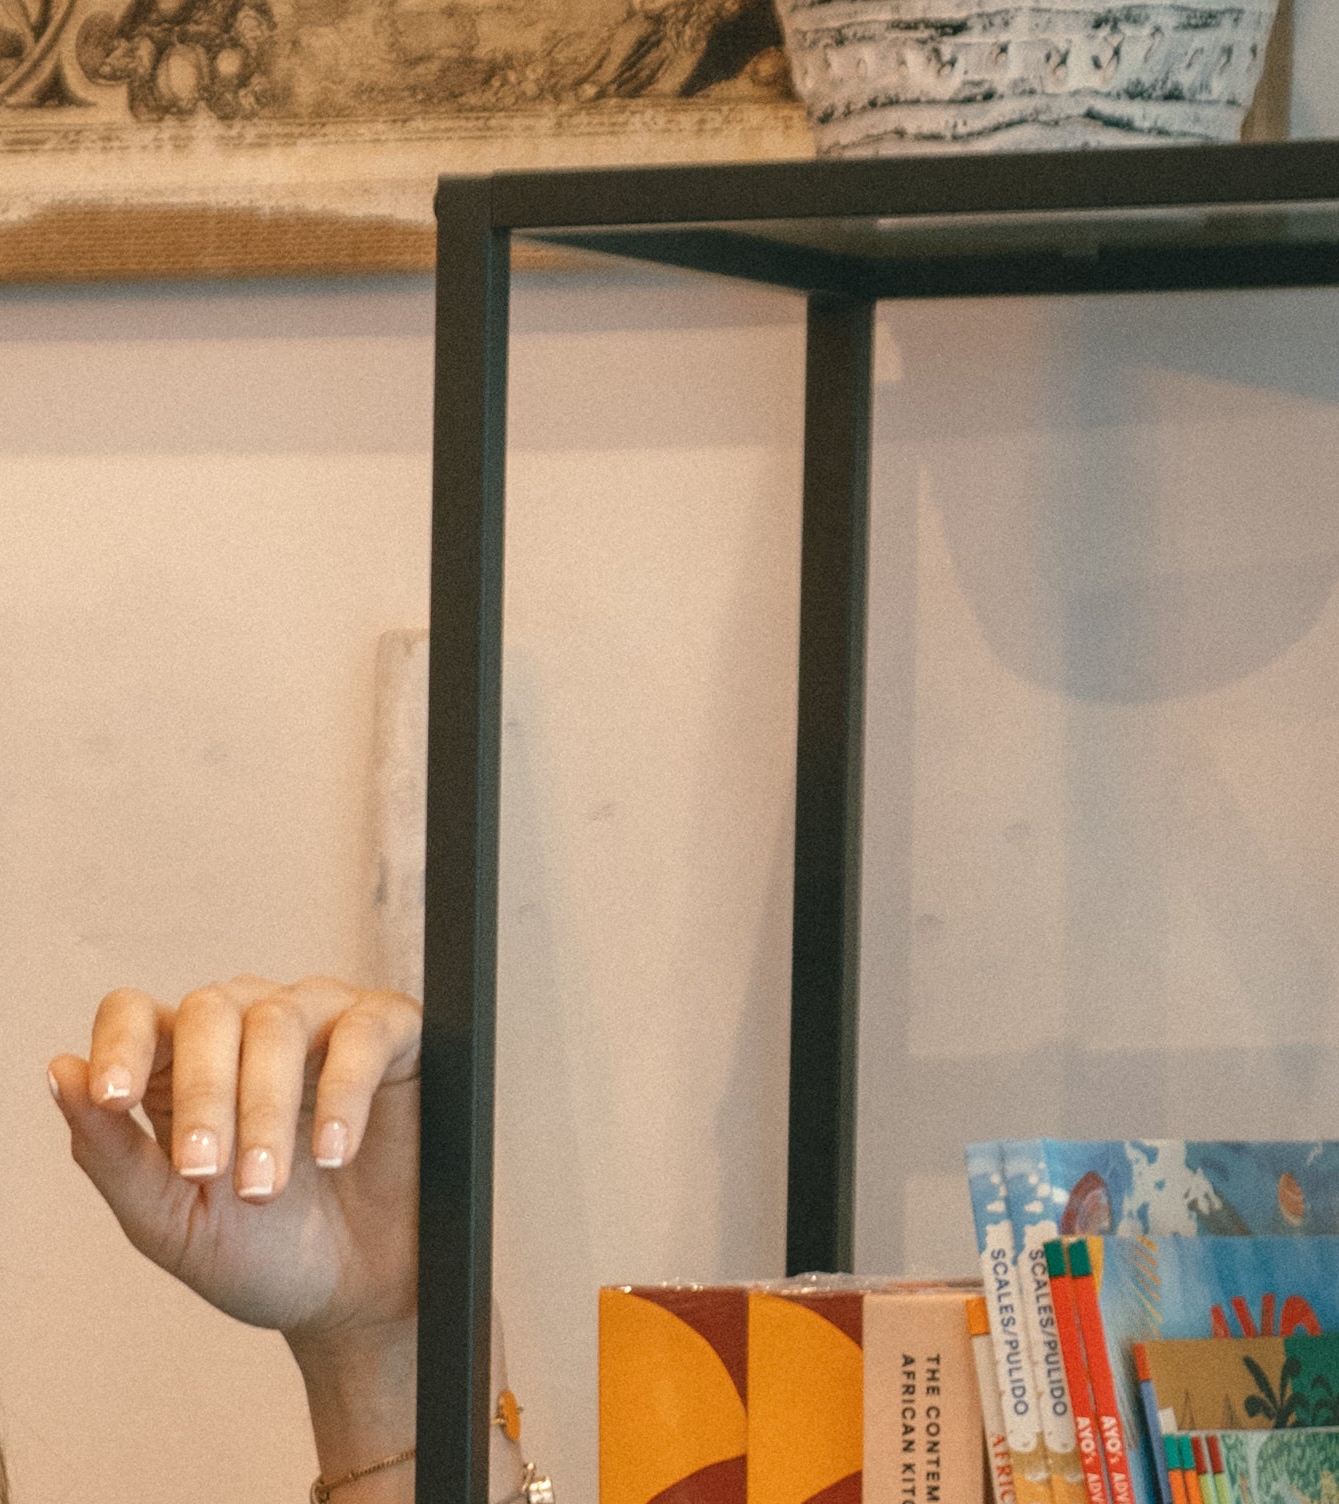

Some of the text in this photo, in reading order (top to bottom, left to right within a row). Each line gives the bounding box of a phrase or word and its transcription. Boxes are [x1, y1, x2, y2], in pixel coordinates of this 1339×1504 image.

[926, 1353, 941, 1396] THE
[991, 1248, 1029, 1416] SCALES/PULIDO
[1029, 1248, 1068, 1416] SCALES/PULIDO
[901, 1353, 916, 1453] AFRICAN
